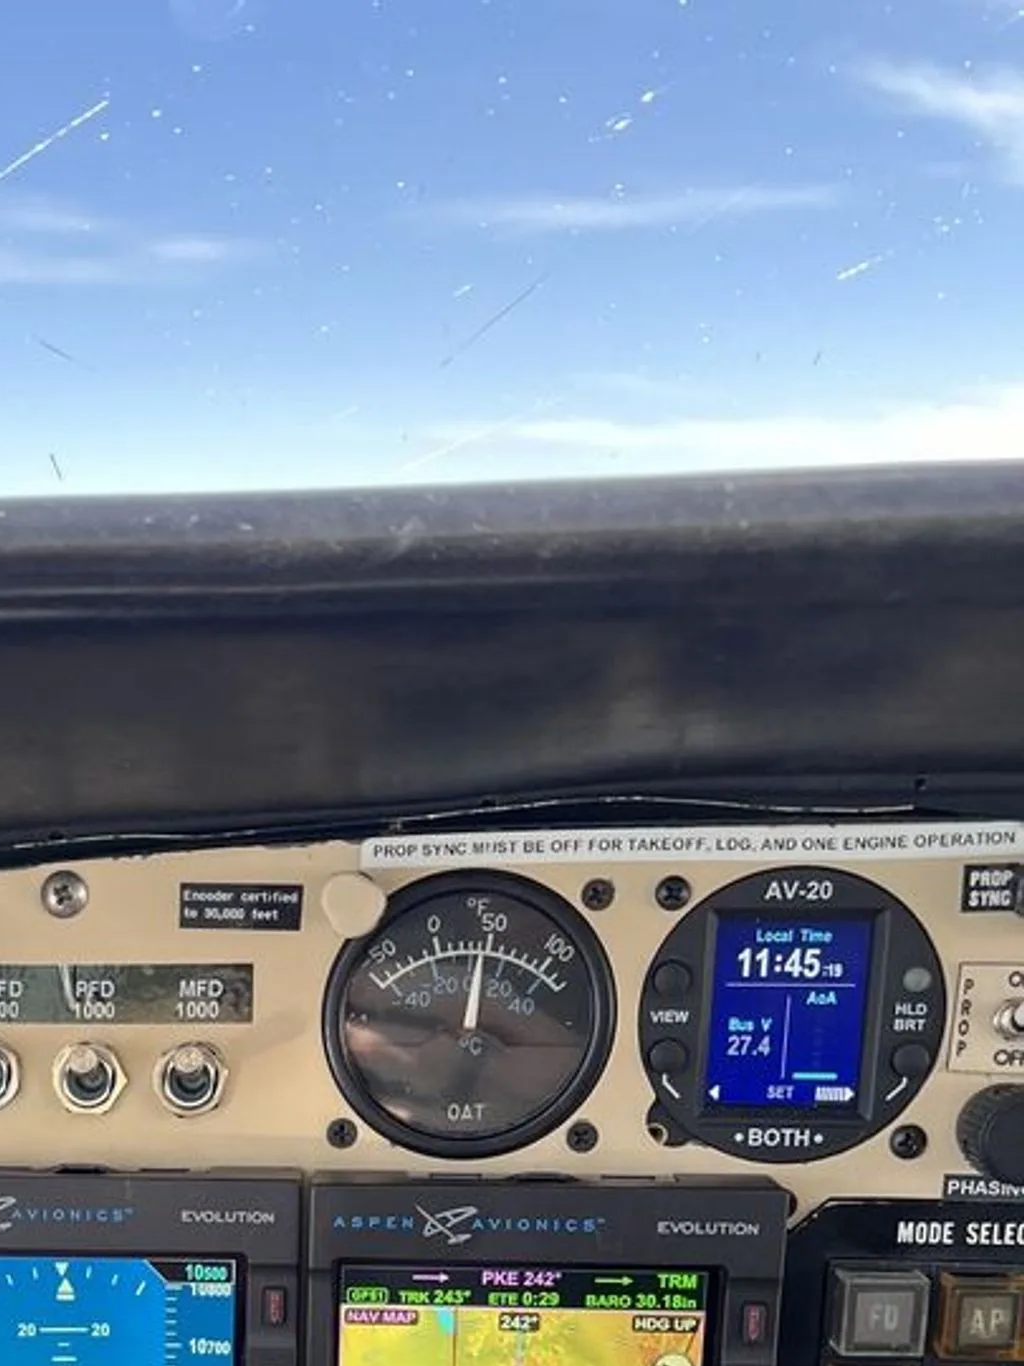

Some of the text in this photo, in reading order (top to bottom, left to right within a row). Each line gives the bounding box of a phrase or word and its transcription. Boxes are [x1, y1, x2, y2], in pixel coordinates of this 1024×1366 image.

[374, 843, 417, 858] PROP
[426, 842, 467, 857] SYNC
[523, 840, 544, 854] BE
[551, 839, 579, 854] OFF
[589, 838, 623, 852] FOR
[761, 837, 796, 851] AND
[802, 836, 837, 851] ONE
[843, 835, 908, 850] ENGINE
[914, 831, 1016, 849] OPERATION
[969, 871, 1013, 887] PROP
[240, 891, 299, 904] certified
[764, 881, 833, 900] AV-20
[968, 890, 1011, 906] SYNC
[184, 907, 279, 920] to feet
[427, 914, 575, 963] 0 50 100
[756, 928, 833, 943] Local Time
[179, 980, 223, 998] MFD
[486, 980, 536, 1015] 20 40
[74, 1002, 115, 1019] 1000
[176, 1002, 219, 1018] 1000
[650, 1010, 689, 1024] VIEW
[895, 1003, 927, 1016] HLD
[728, 1018, 773, 1032] Bus V
[893, 1018, 926, 1031] BRT
[727, 1036, 771, 1057] 27.4
[766, 1086, 794, 1099] SET
[447, 1103, 486, 1120] OAT
[748, 1128, 810, 1147] BOTH
[181, 1210, 275, 1225] EVOLUTION
[333, 1216, 414, 1229] ASPEN
[657, 1221, 759, 1236] EVOLUTION
[897, 1221, 955, 1245] MODE
[185, 1264, 228, 1280] 10500
[483, 1270, 518, 1286] PKE
[658, 1274, 697, 1289] TRM
[399, 1290, 429, 1304] TRK
[488, 1291, 560, 1306] ETE 0:29
[586, 1294, 631, 1309] BARO
[347, 1310, 417, 1324] NAV MAP
[634, 1317, 697, 1331] HDG UP
[970, 1308, 1005, 1336] AP
[17, 1324, 110, 1337] 20 20
[189, 1340, 232, 1355] 10700
